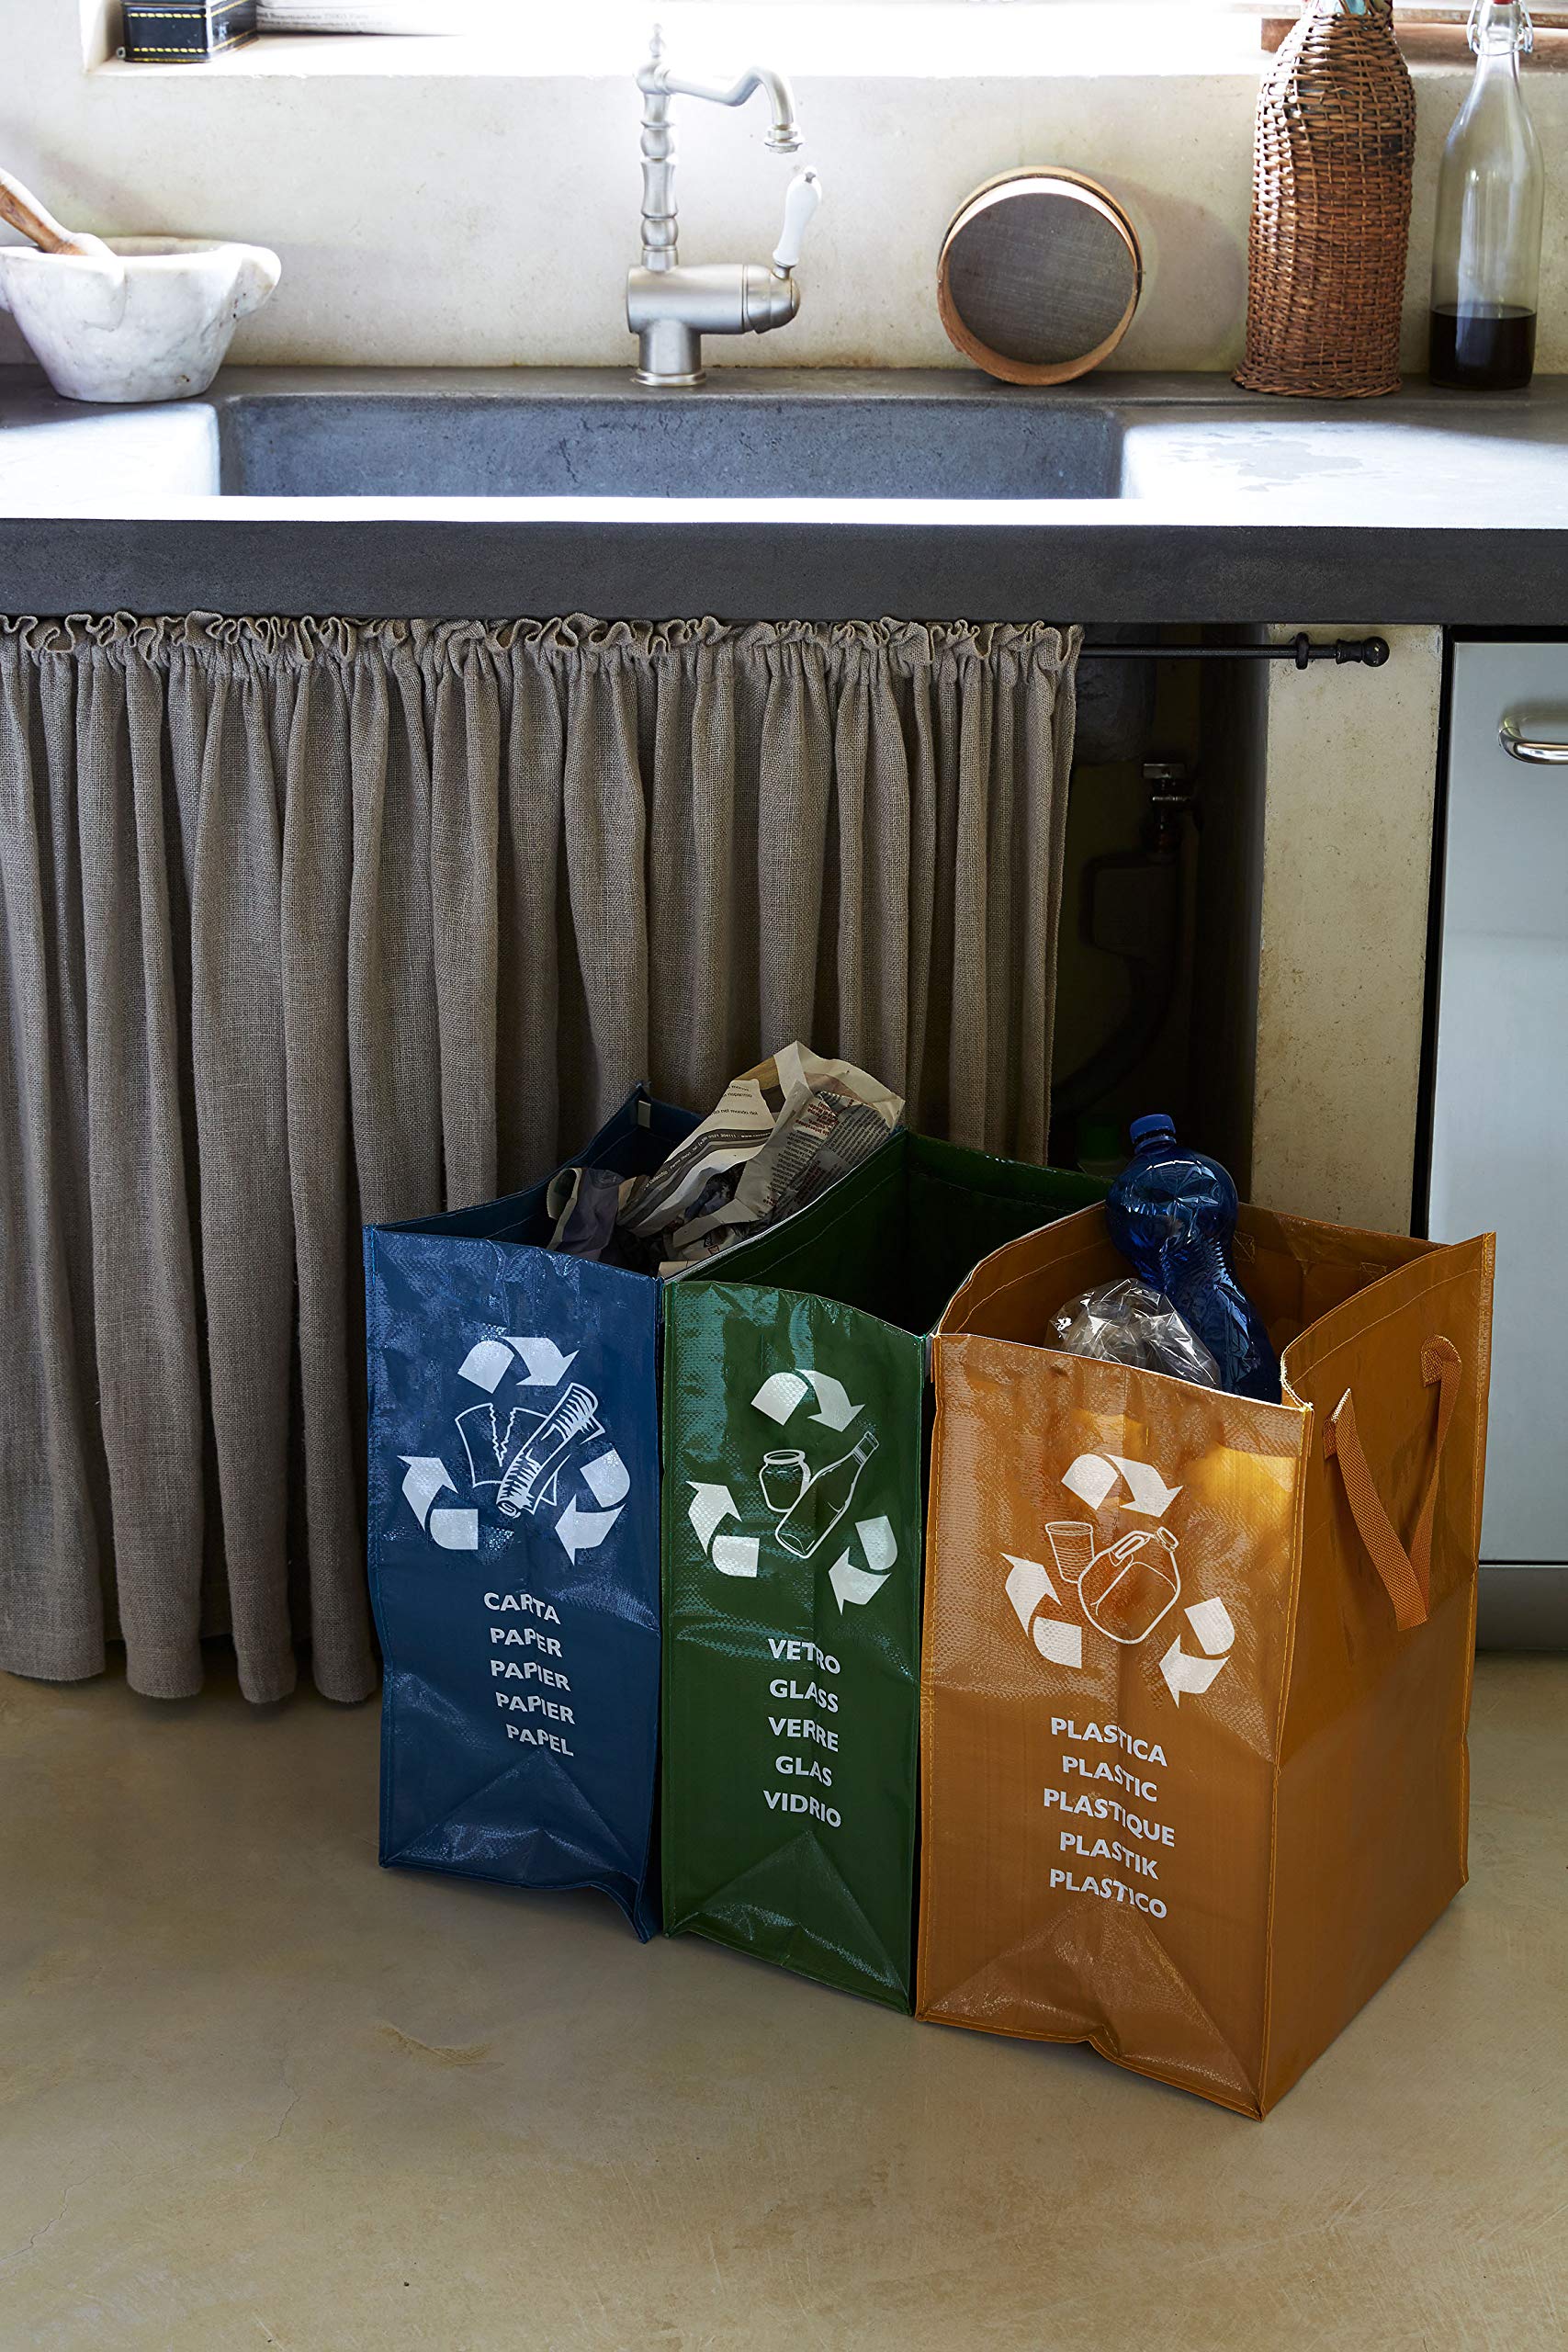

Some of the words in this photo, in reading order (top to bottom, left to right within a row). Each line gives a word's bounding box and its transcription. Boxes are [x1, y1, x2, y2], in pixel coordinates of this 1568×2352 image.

[483, 1592, 561, 1625] CARTA
[490, 1627, 562, 1657] PAPER
[767, 1638, 840, 1675] VETRO
[490, 1659, 571, 1691] PAPIER
[495, 1691, 576, 1724] PAPIER
[769, 1679, 839, 1713] GLASS
[505, 1724, 574, 1757] PAPEL
[768, 1716, 839, 1753] VERRE
[1051, 1716, 1168, 1767] PLASTICA
[775, 1756, 832, 1787] GLAS
[1062, 1755, 1157, 1803] PLASTIC
[762, 1790, 841, 1827] VIDRIO
[1043, 1788, 1175, 1848] PLASTIQUE
[1060, 1831, 1159, 1880] PLASTIK
[1049, 1868, 1168, 1918] PLASTICO
